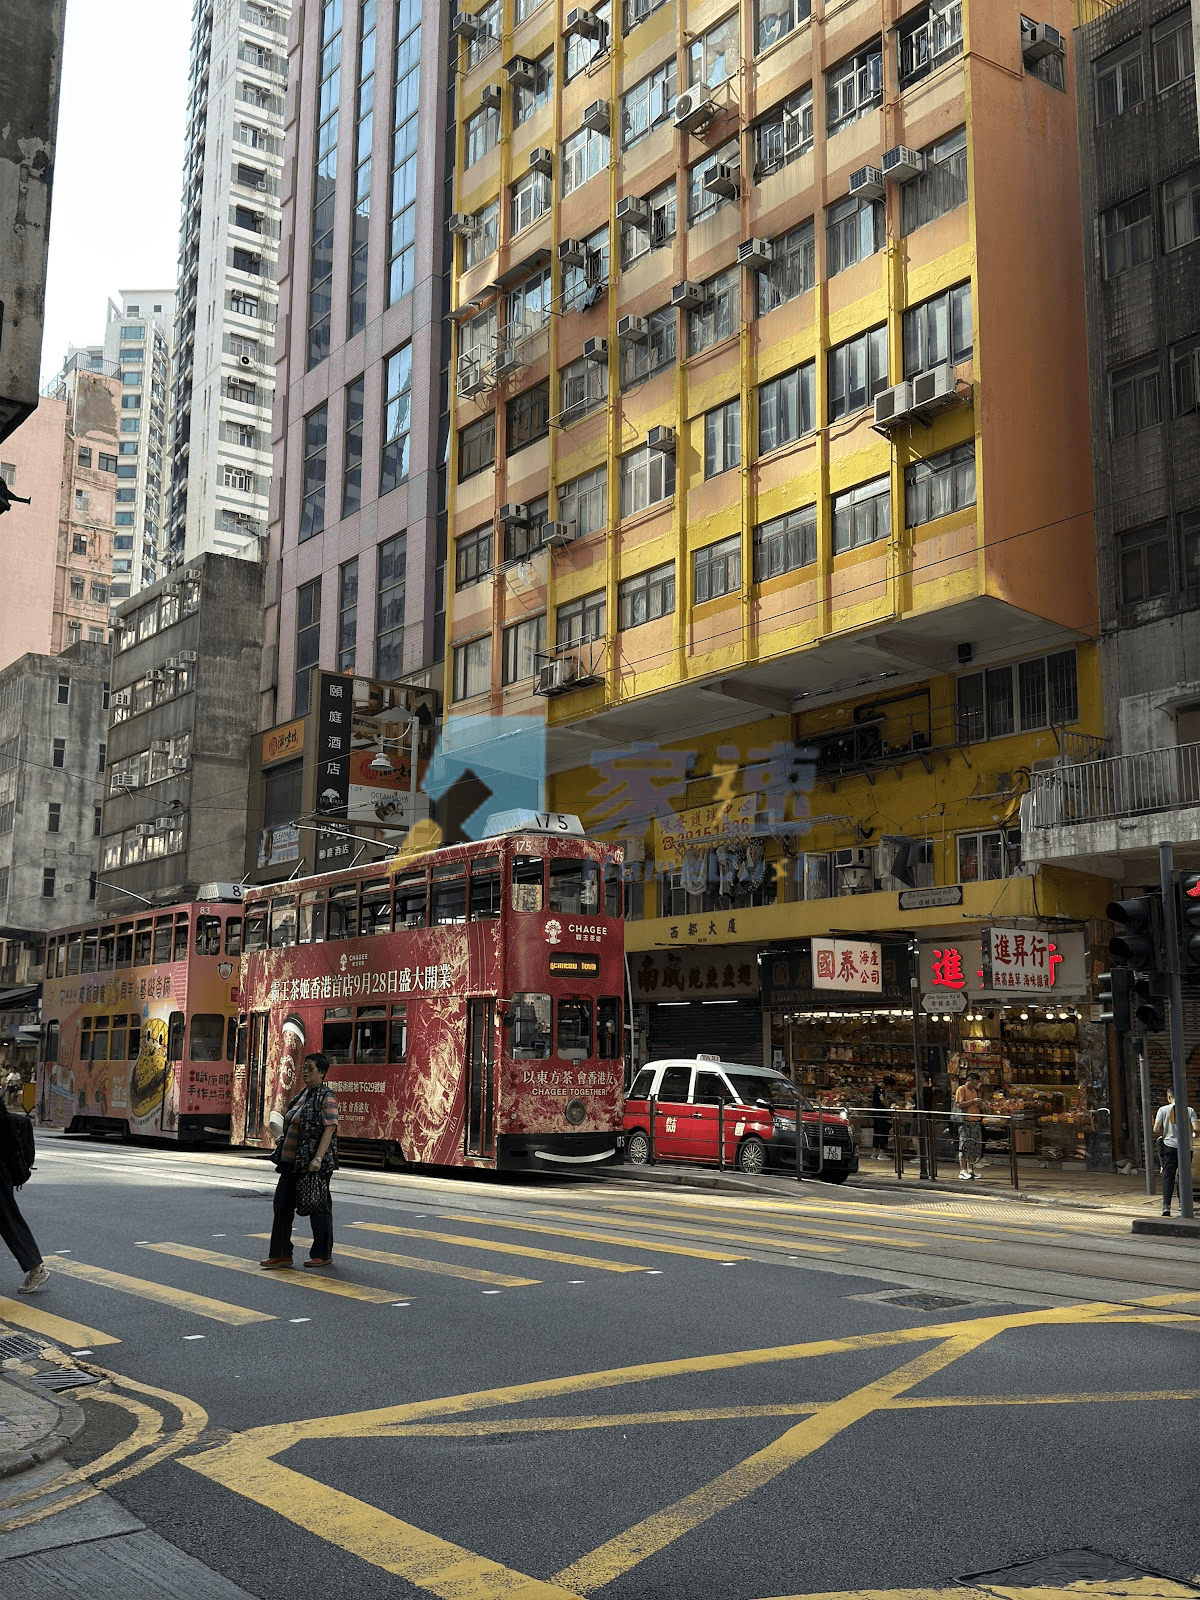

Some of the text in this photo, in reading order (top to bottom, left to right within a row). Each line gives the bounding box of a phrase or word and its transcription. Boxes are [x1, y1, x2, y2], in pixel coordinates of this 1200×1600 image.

[327, 684, 344, 776] 頤庭酒店
[535, 813, 569, 830] 175
[516, 841, 532, 852] 175
[200, 906, 211, 915] 83
[568, 924, 607, 935] CHAGEE
[670, 918, 738, 939] 西都大廈
[859, 950, 879, 966] 海產
[994, 934, 1047, 967] 進昇行
[817, 949, 859, 983] 國泰
[270, 964, 452, 1002] 霸王茶姬香港首店9月28日盛大開業
[860, 970, 880, 985] 公司
[523, 1070, 615, 1085] 以東方茶 會香港友
[532, 1088, 608, 1096] CHAGEE TOGETHER!
[665, 1125, 677, 1133] TAXI
